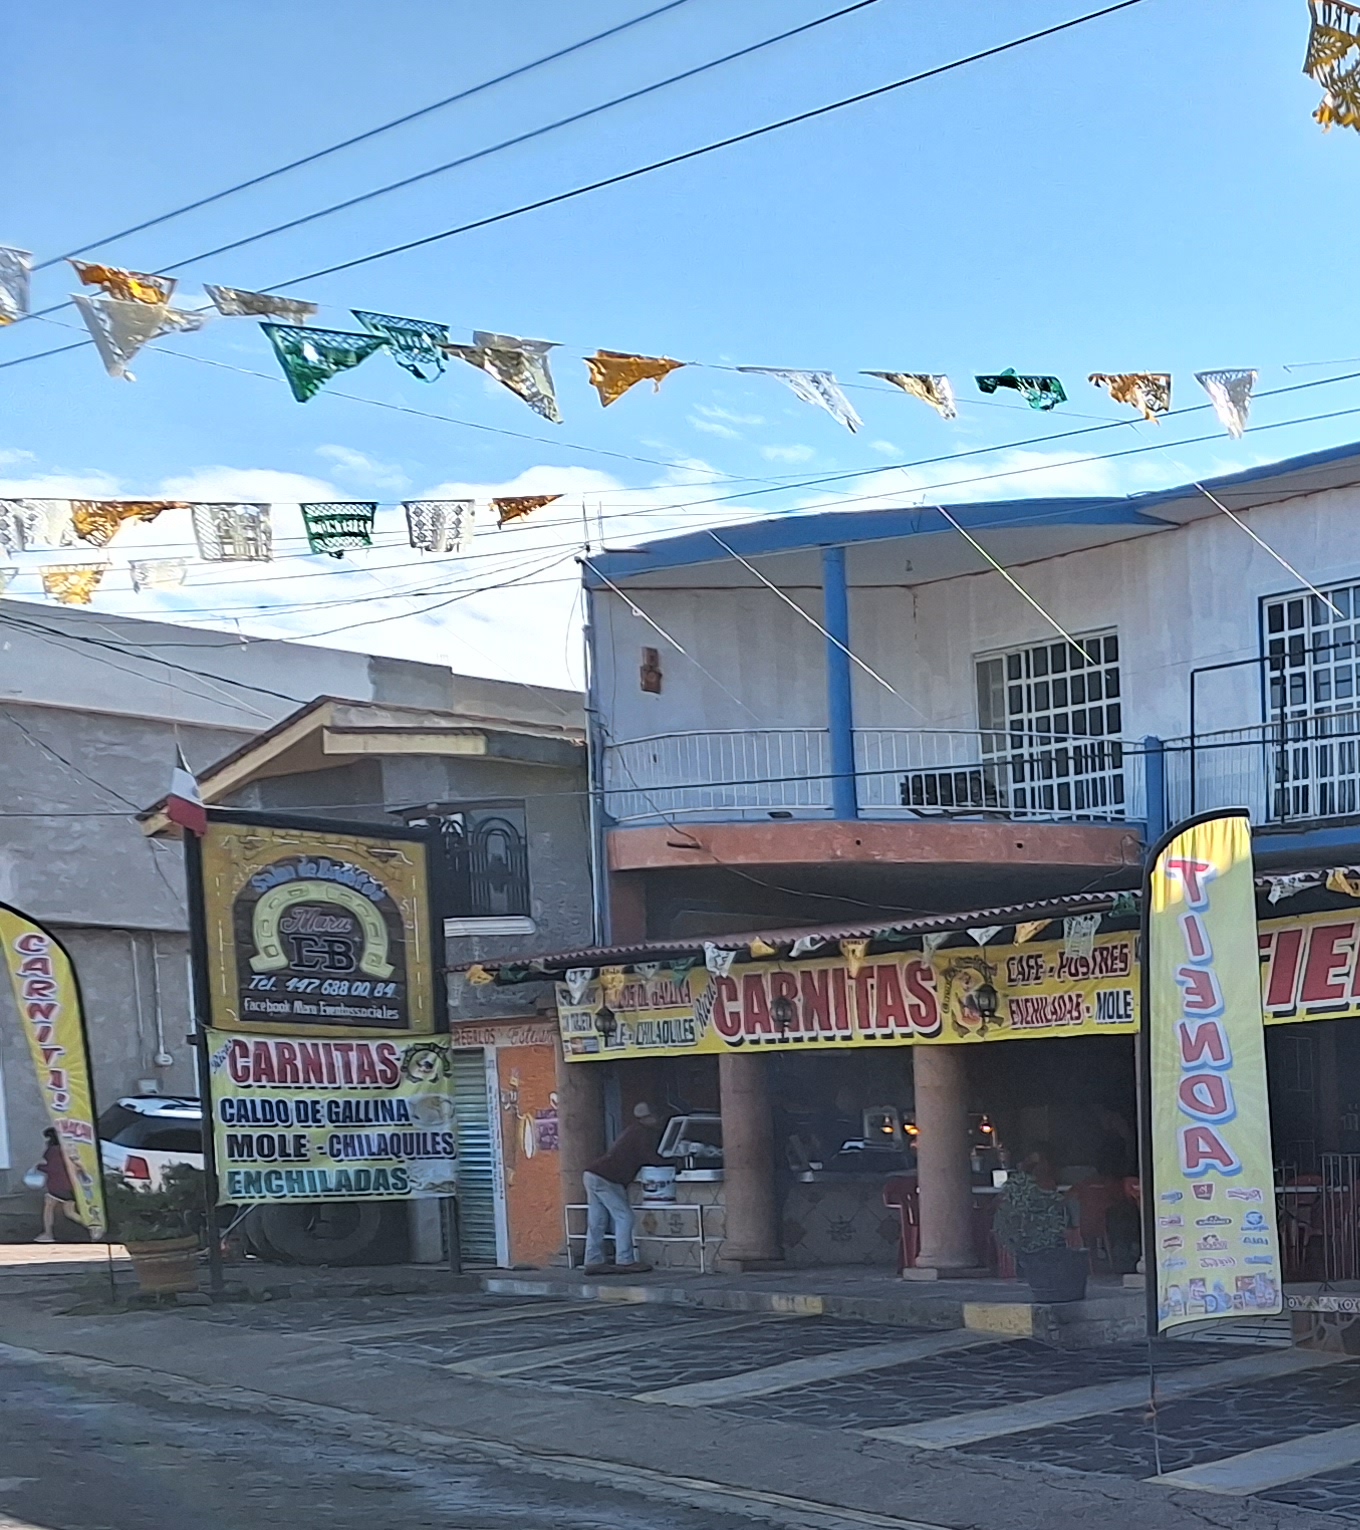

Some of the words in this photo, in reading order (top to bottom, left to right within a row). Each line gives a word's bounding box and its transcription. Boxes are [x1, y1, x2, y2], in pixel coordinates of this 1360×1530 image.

[1007, 953, 1044, 983] CAFE
[321, 979, 349, 995] 688
[351, 981, 370, 998] 00
[712, 960, 941, 1041] CARNITAS
[244, 998, 291, 1013] Facebook
[1008, 992, 1084, 1026] ENCHILADAS
[1095, 990, 1133, 1021] MOLE
[228, 1038, 401, 1087] CARNITAS
[220, 1097, 291, 1124] CALDO
[295, 1099, 324, 1124] DE
[326, 1098, 411, 1124] GALLINA
[226, 1133, 309, 1159] MOLE
[226, 1168, 411, 1196] ENCHILADAS
